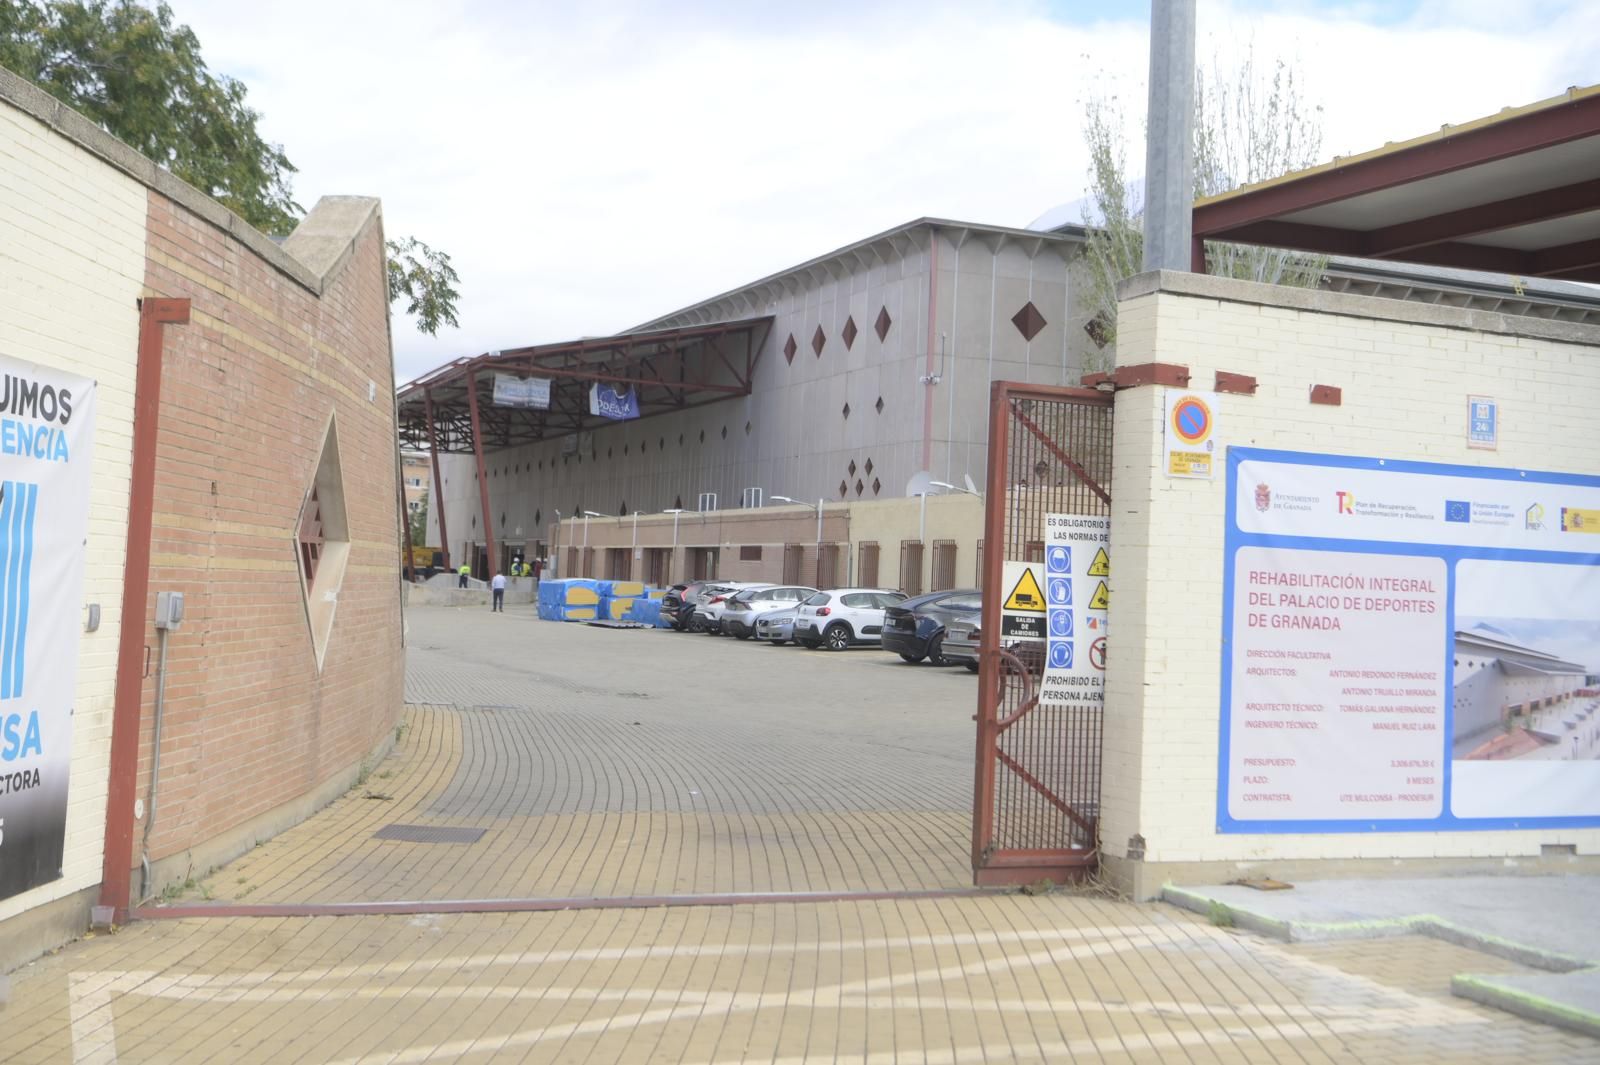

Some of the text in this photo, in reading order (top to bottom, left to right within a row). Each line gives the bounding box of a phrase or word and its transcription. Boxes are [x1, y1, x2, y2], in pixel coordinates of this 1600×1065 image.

[1, 418, 68, 462] ENCIA
[1048, 518, 1111, 529] ES OBLIGATORIO S
[1054, 532, 1108, 542] LAS NORMAS DE
[1249, 571, 1436, 593] REHABILITACIÓN INTEGRAL
[1249, 592, 1435, 613] DEL PALACIO DE DEPORTES
[1248, 613, 1341, 630] DE GRANADA
[1046, 676, 1089, 686] PROHIBIDO
[1091, 677, 1100, 686] EL
[1329, 670, 1360, 678] ANTONIO
[1043, 690, 1080, 700] PERSONA
[0, 710, 42, 762] SA
